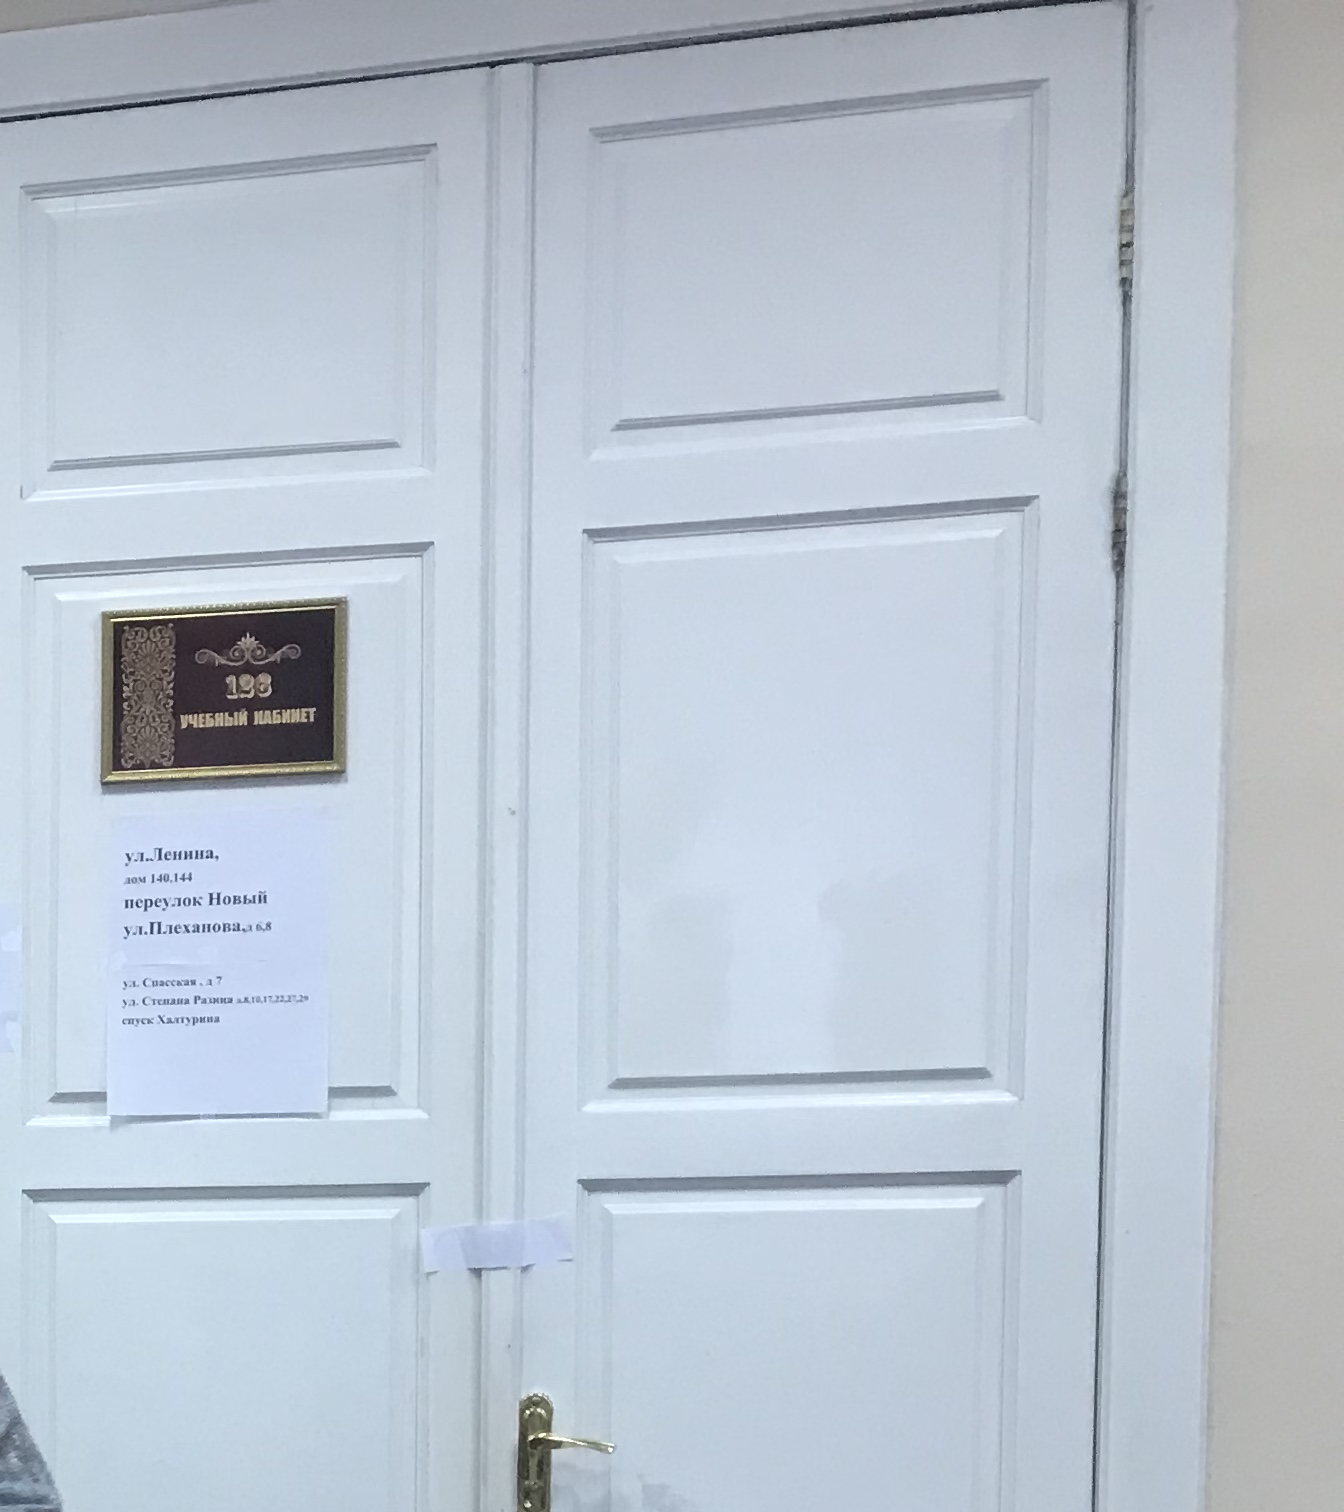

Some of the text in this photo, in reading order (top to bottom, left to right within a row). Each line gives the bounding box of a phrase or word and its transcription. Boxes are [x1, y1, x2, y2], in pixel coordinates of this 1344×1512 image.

[180, 707, 316, 729] УЧЕБНЫЙ КАБИНЕТ
[125, 848, 219, 866] ул.Ленина,
[124, 872, 192, 884] дом 140,144
[124, 891, 267, 912] переулок Новый
[122, 980, 139, 990] ул.
[143, 977, 196, 988] Спасская
[216, 976, 222, 985] 7
[122, 998, 138, 1009] ул.
[142, 996, 190, 1006] Степана
[193, 995, 233, 1004] Разина
[122, 1014, 220, 1027] спуск Халтурина
